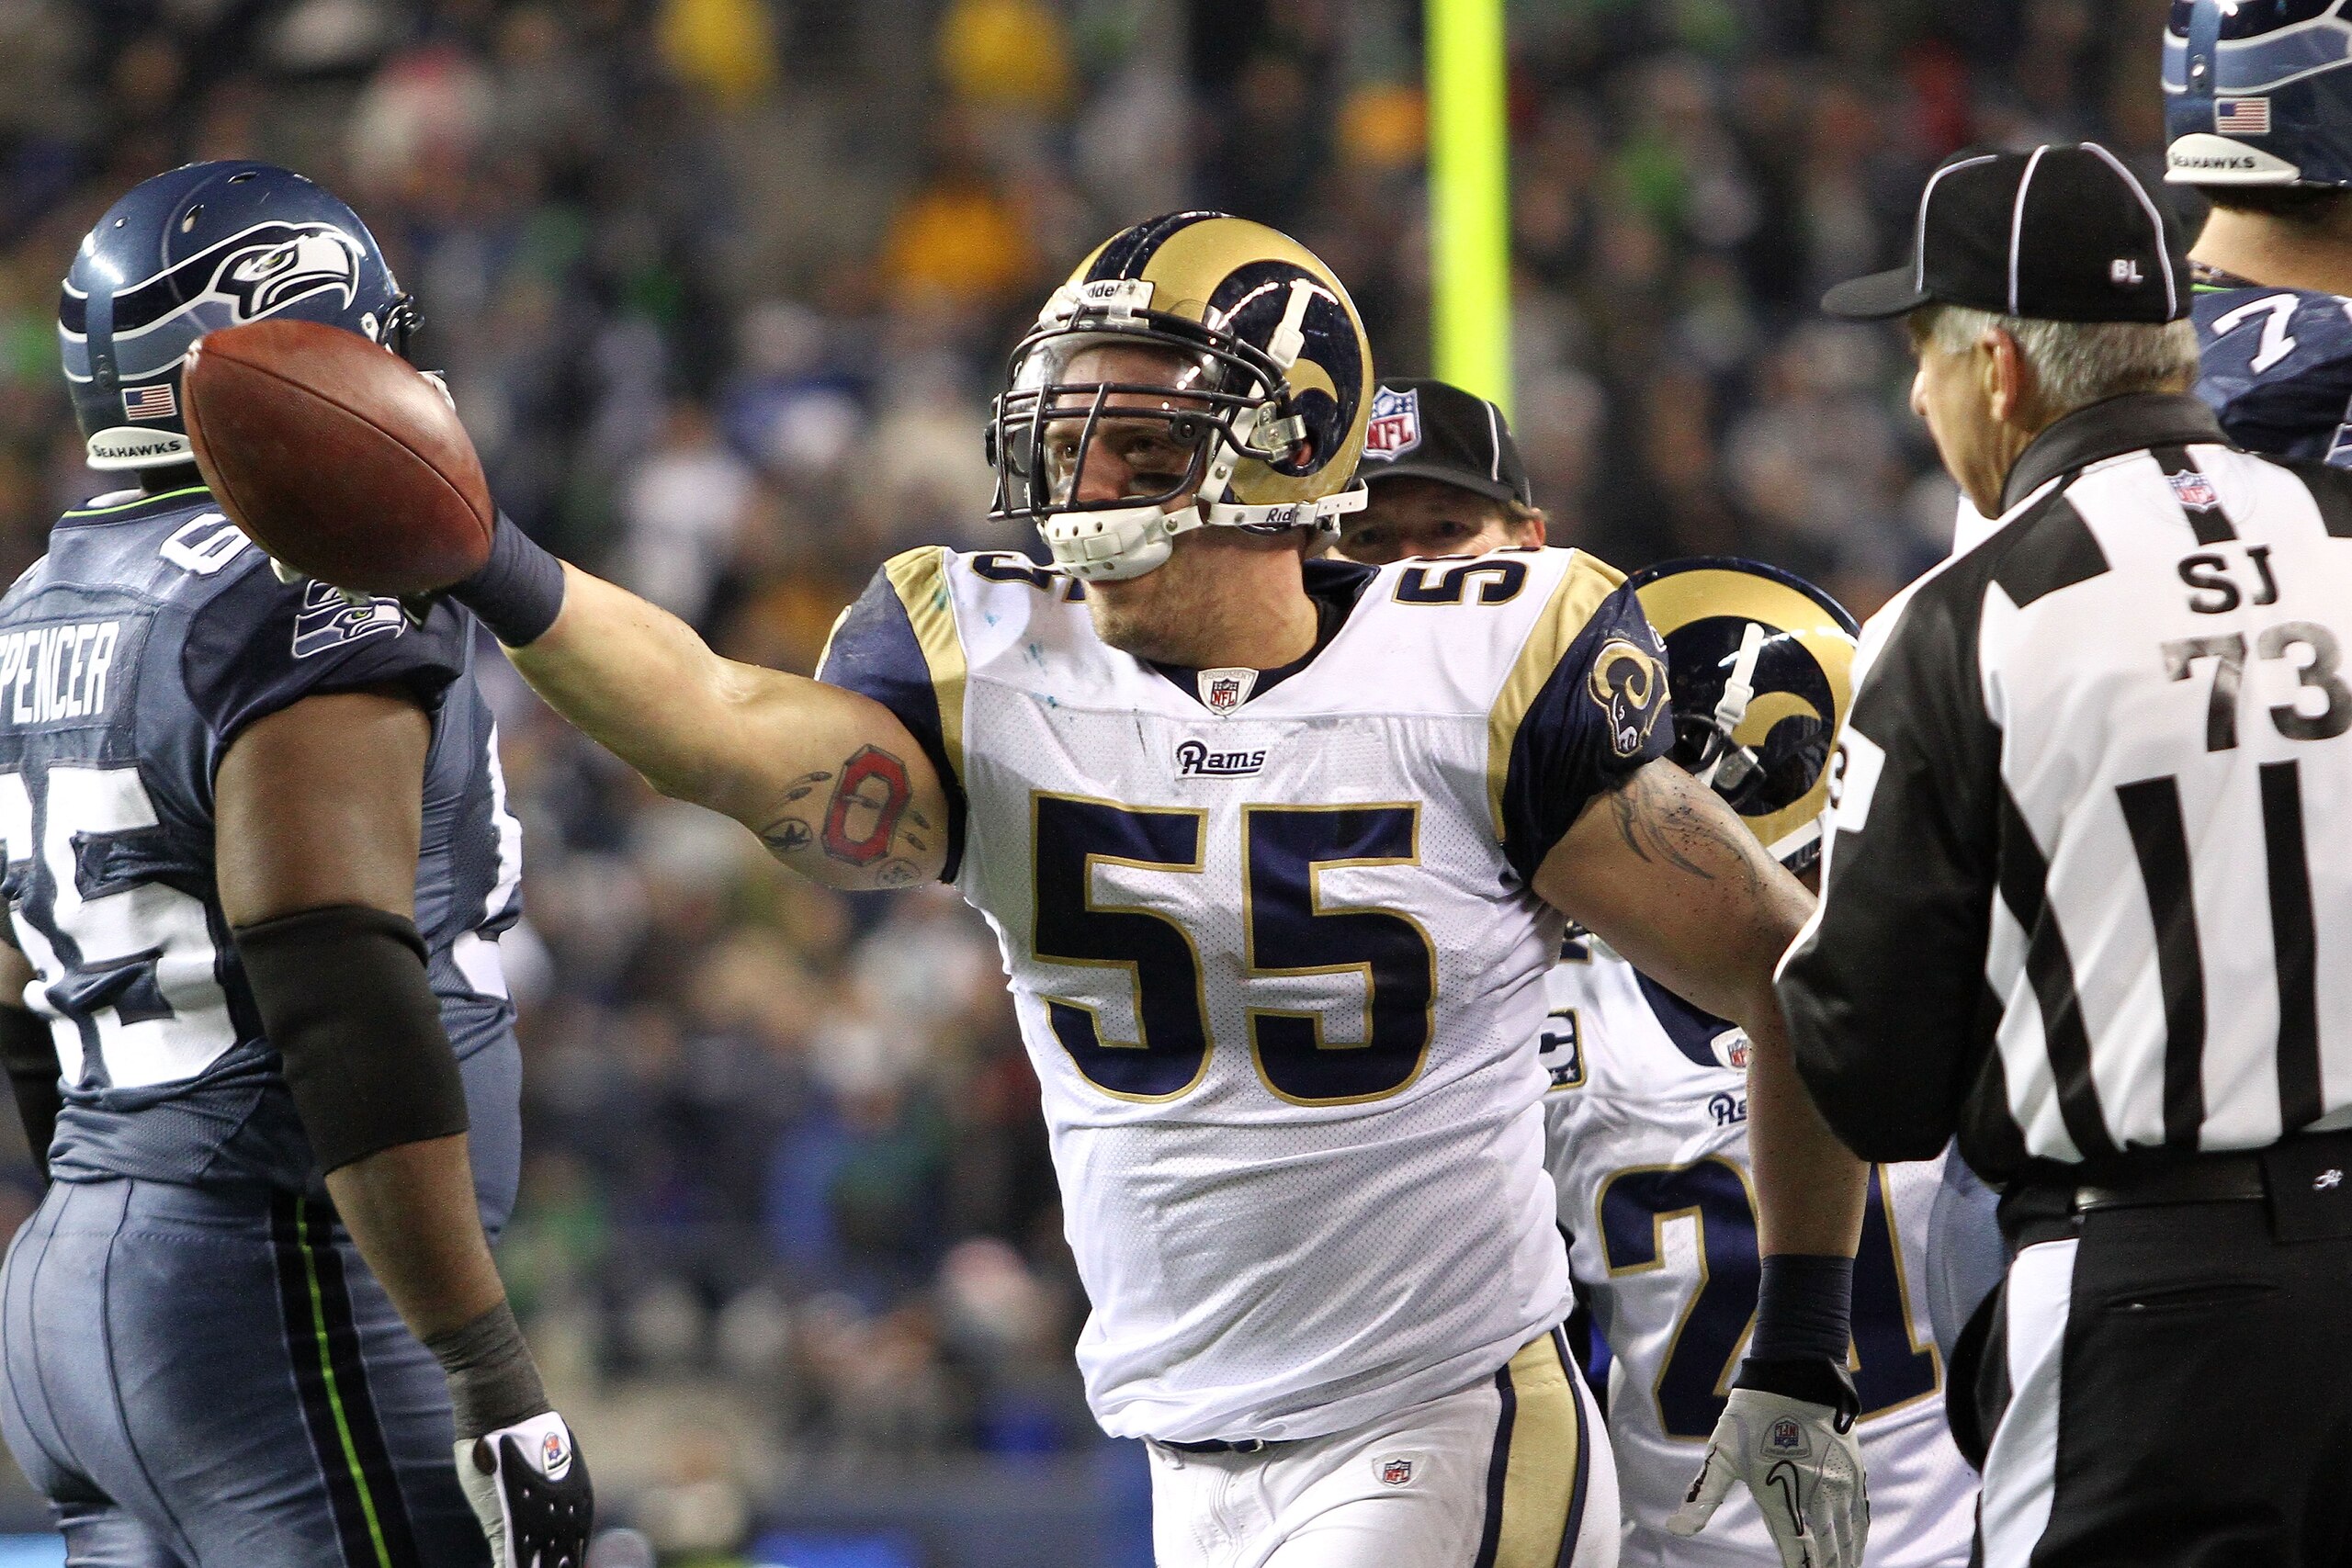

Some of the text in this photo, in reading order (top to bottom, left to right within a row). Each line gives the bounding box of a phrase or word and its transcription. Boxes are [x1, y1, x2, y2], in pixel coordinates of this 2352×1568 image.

[2110, 259, 2143, 284] BL
[93, 440, 182, 457] SEAHAWKS
[1366, 415, 1417, 450] NFL
[2177, 544, 2279, 614] SJ
[0, 621, 120, 725] PENCER
[2161, 620, 2352, 752] 73
[1212, 689, 1238, 707] NFL
[1176, 739, 1267, 775] Rams
[1030, 790, 1439, 1108] 55
